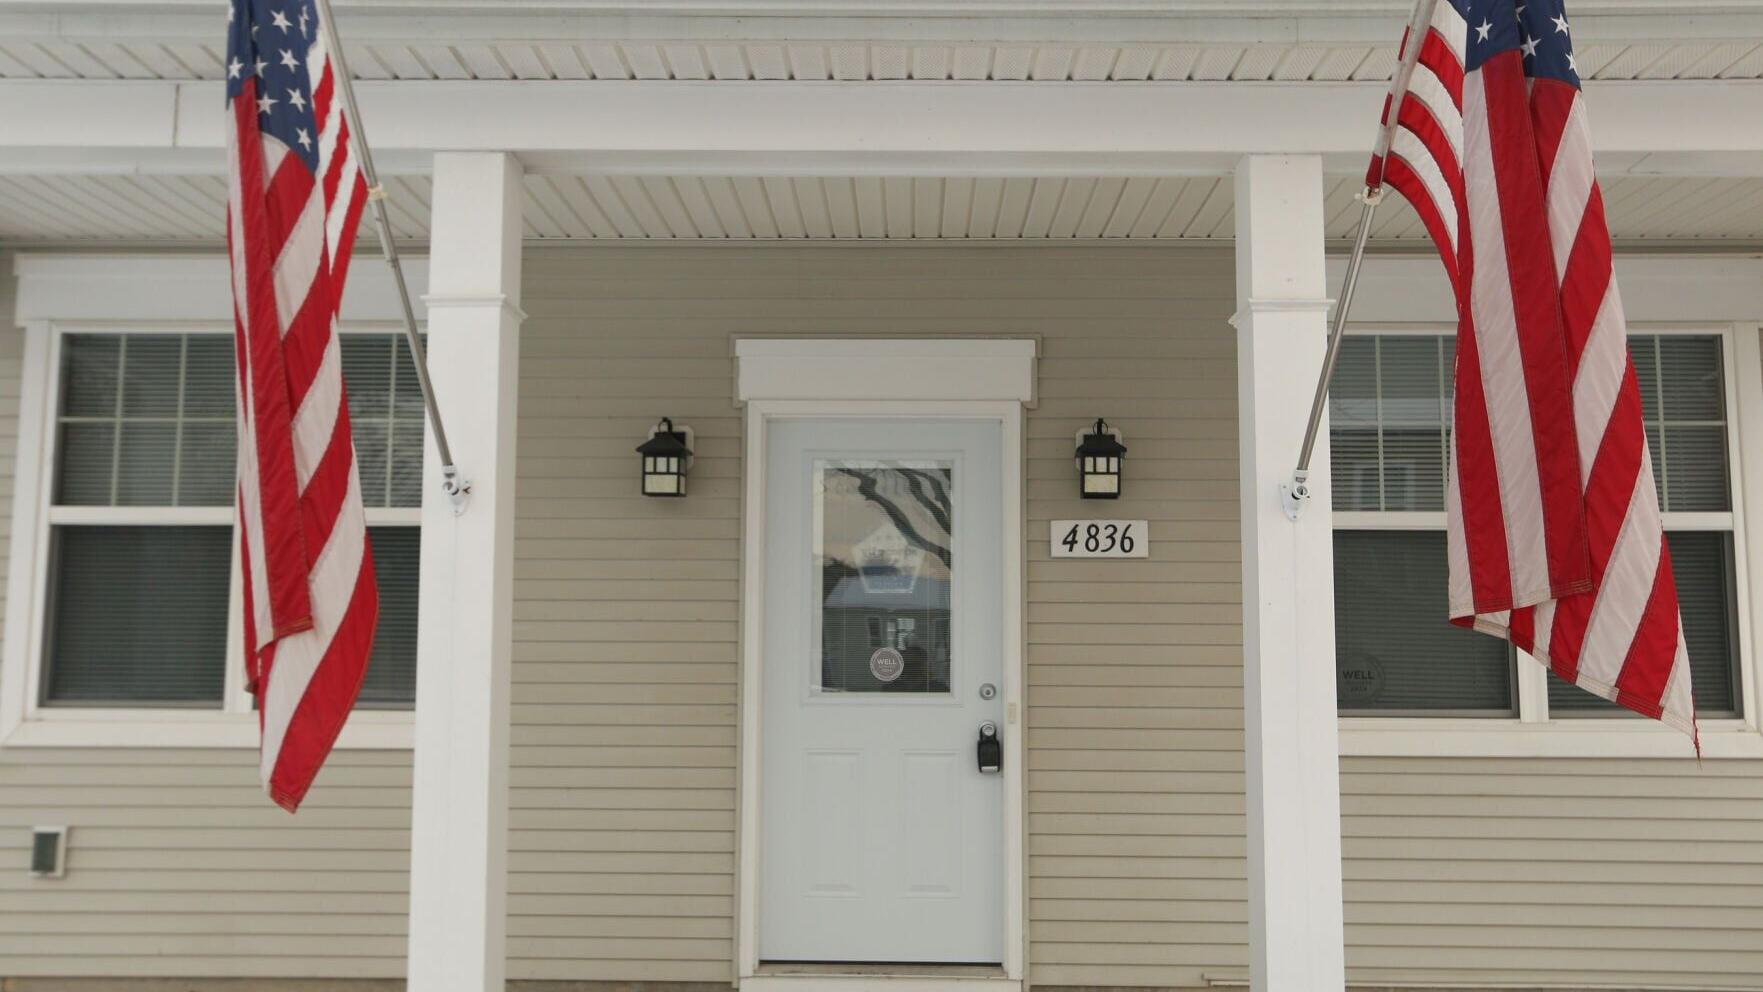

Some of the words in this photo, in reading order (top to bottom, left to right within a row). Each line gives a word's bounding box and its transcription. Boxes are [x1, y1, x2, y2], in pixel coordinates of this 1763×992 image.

[1062, 523, 1134, 553] 4836
[876, 658, 897, 666] WELL
[1342, 670, 1375, 680] WELL
